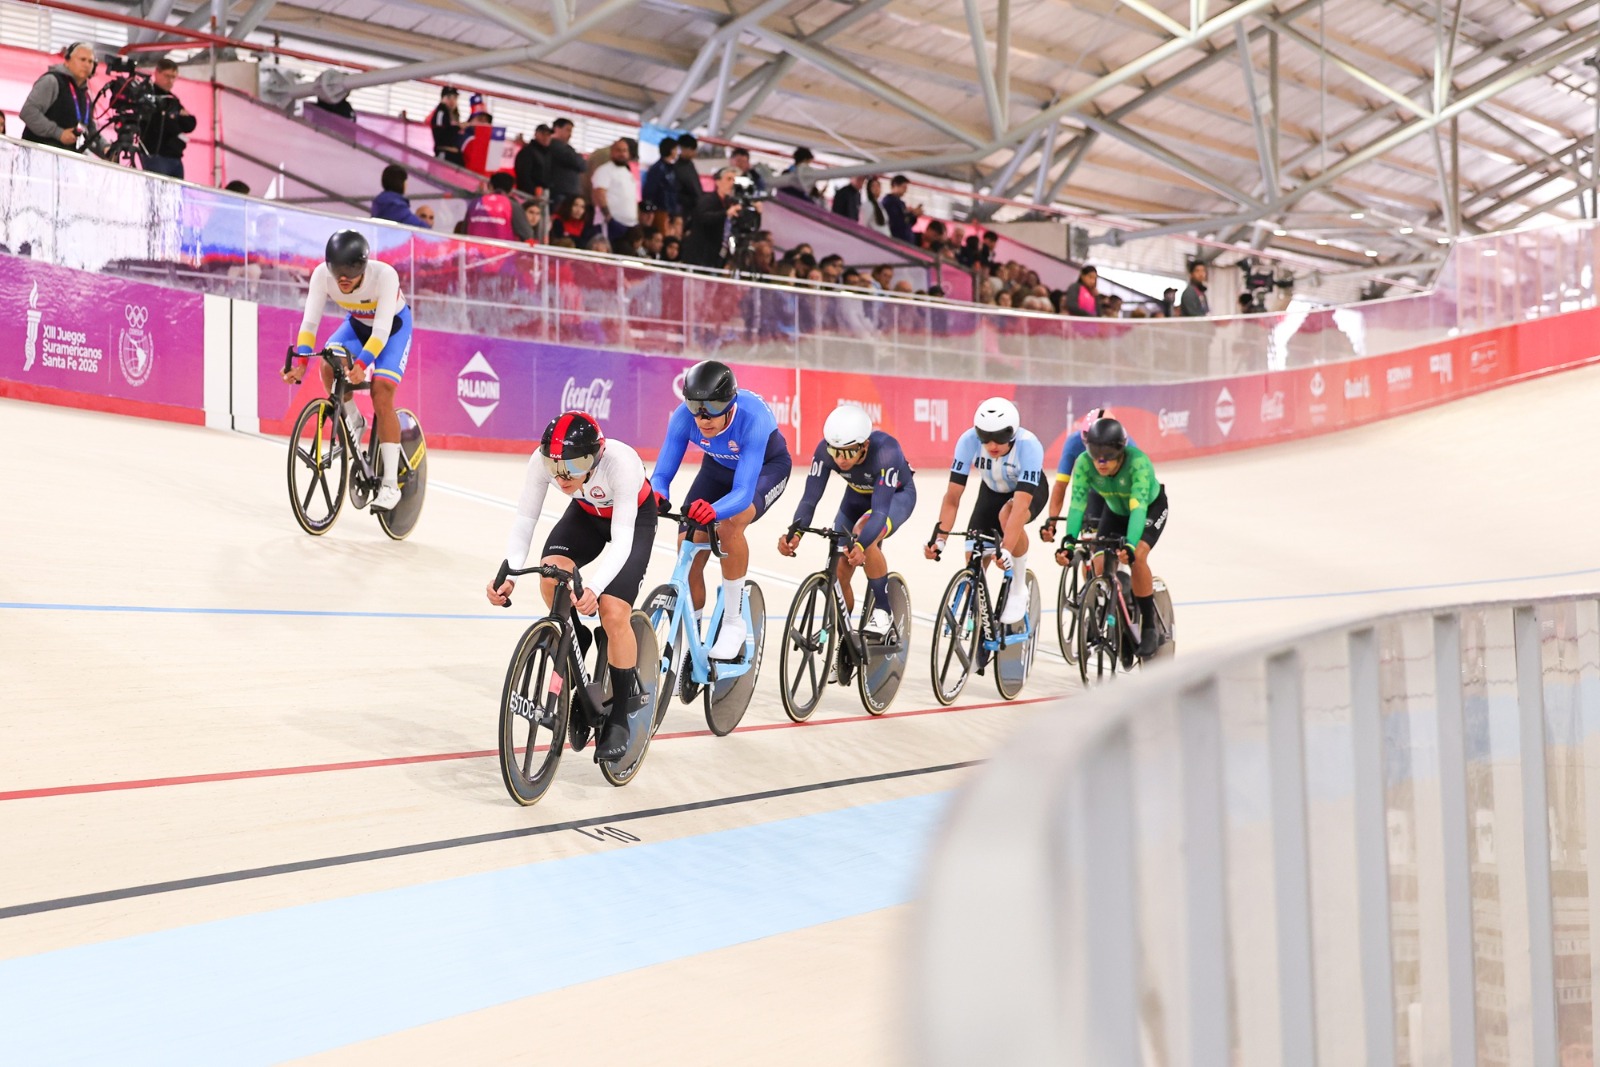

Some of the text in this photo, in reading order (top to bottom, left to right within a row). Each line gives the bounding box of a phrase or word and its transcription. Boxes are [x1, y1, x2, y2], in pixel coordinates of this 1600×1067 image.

[57, 327, 86, 346] Juegos
[42, 338, 102, 360] Suramericanos
[42, 353, 98, 373] Santa Fe 2026
[457, 378, 500, 400] PALADINI
[974, 457, 992, 470] ARG
[978, 581, 994, 642] PINARELLO
